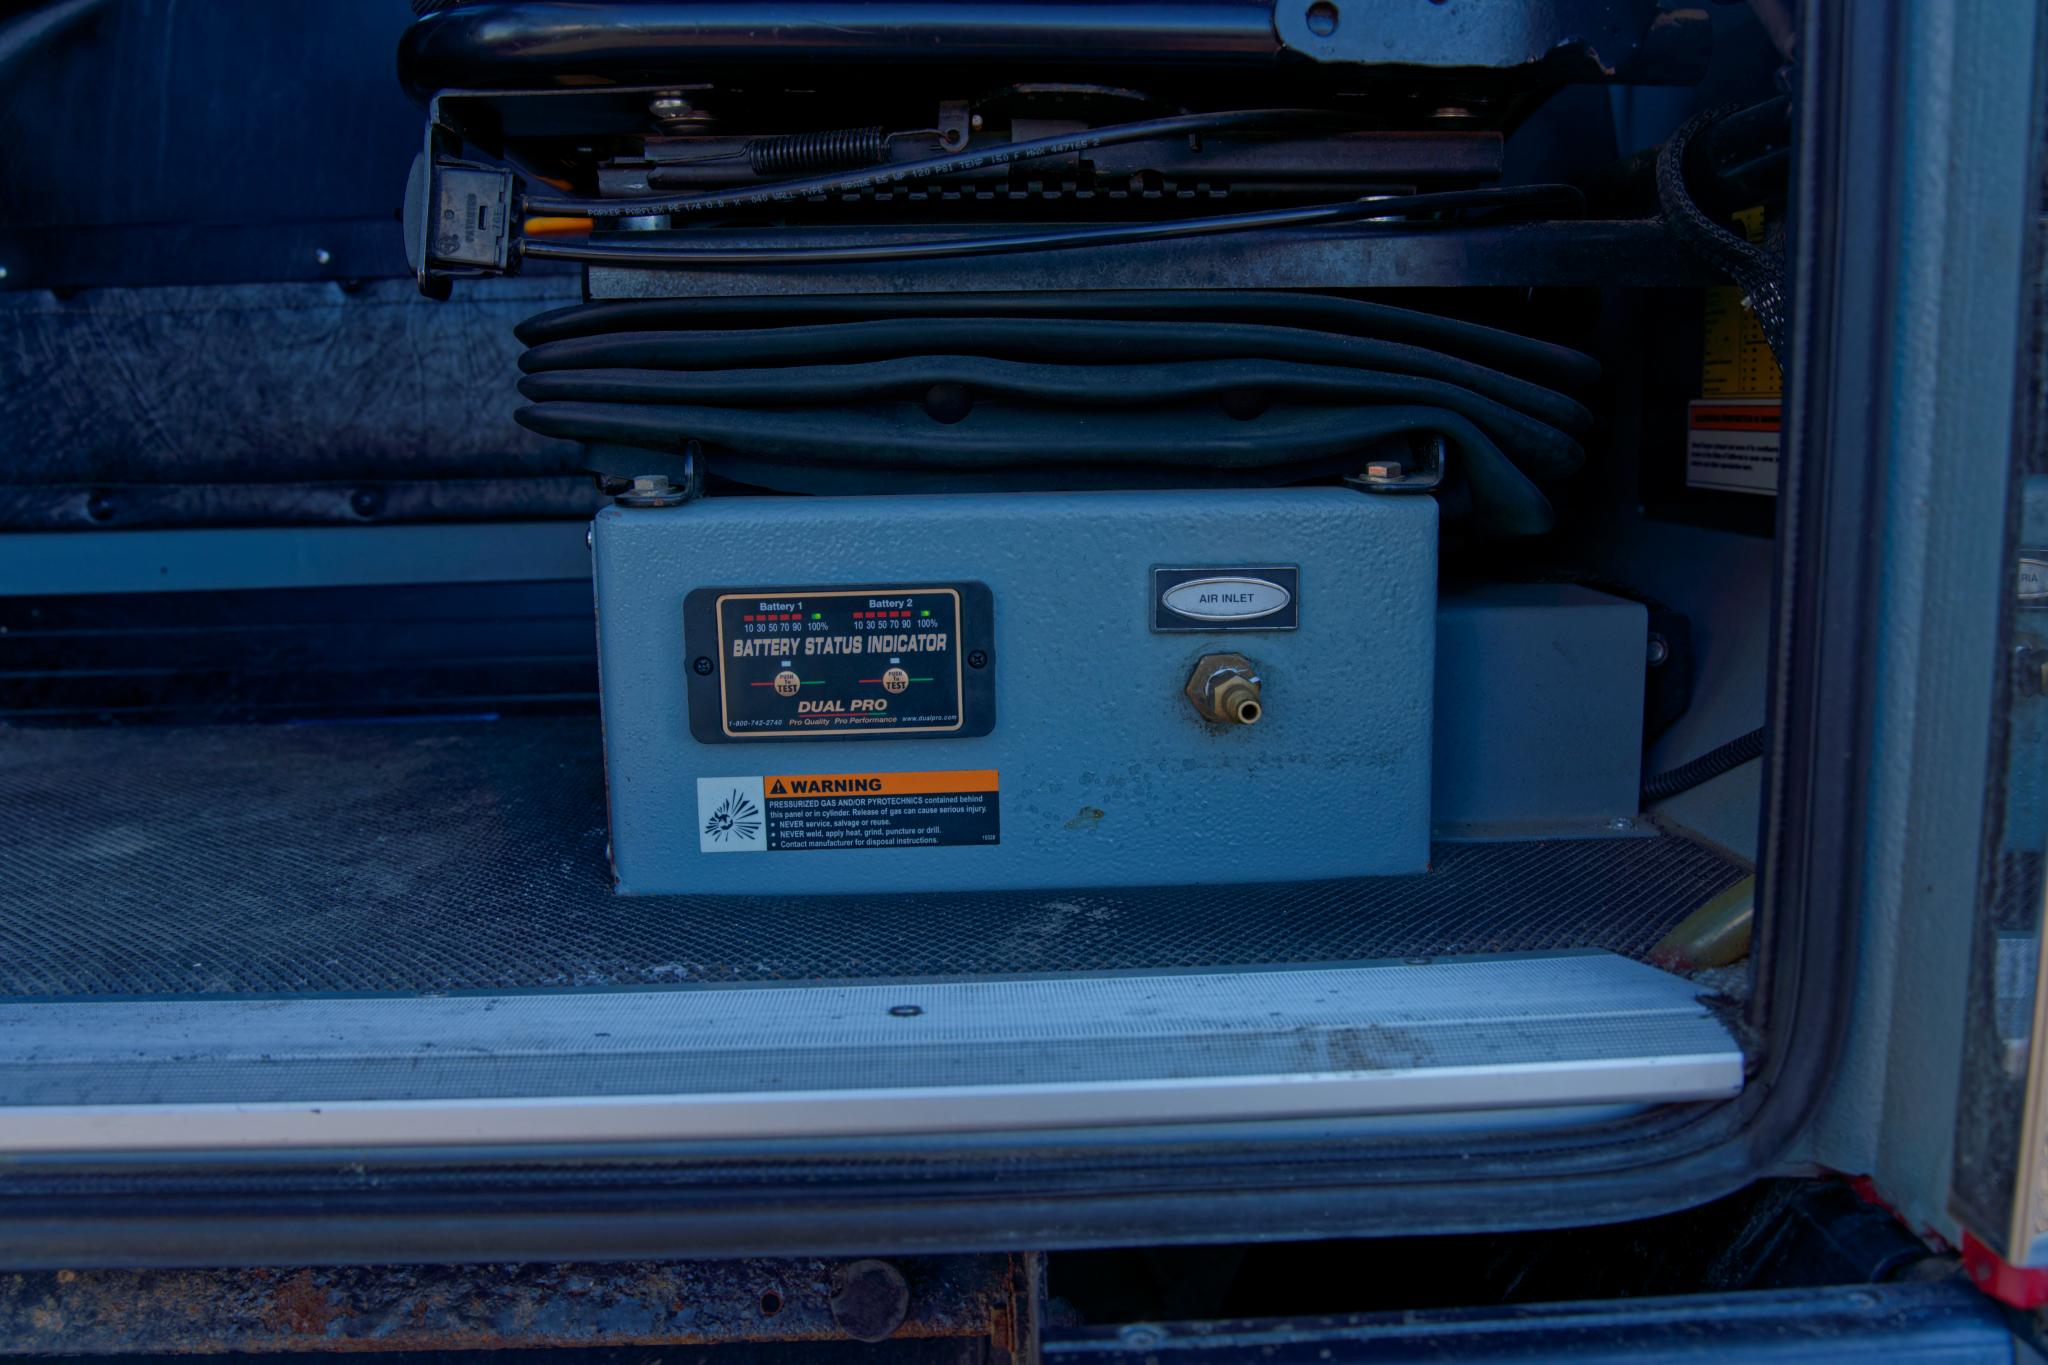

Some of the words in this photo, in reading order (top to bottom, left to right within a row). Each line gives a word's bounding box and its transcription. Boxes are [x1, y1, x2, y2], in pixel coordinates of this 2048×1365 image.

[800, 185, 825, 196] TYPE
[912, 168, 931, 178] 120
[935, 163, 953, 175] PSI
[959, 158, 984, 169] TEMP
[991, 153, 1009, 164] 150
[869, 599, 904, 609] Battery
[906, 598, 913, 607] 2
[1199, 594, 1218, 603] AIR
[1222, 593, 1255, 603] INLET
[760, 602, 795, 612] Battery
[797, 601, 803, 610] 1
[744, 623, 754, 633] 10
[756, 623, 766, 633] 30
[768, 623, 778, 632] 50
[780, 622, 790, 632] 70
[792, 622, 802, 631] 90
[807, 622, 829, 631] 100%
[854, 620, 863, 630] 10
[866, 620, 876, 629] 30
[878, 620, 887, 629] 50
[889, 619, 899, 629] 70
[901, 619, 911, 628] 90
[917, 618, 938, 628] 100%
[733, 637, 801, 657] BATTERY
[804, 635, 863, 655] STATUS
[867, 633, 947, 653] INDICATOR
[778, 684, 797, 693] TEST
[886, 682, 906, 690] TEST
[797, 699, 845, 713] DUAL
[850, 698, 888, 712] PRO
[804, 718, 830, 726] Quality
[834, 717, 848, 725] Pro
[849, 716, 897, 725] Performance
[902, 714, 957, 722] www.dualpro.com
[790, 778, 882, 793] WARNING
[769, 800, 819, 808] PRESSURIZED
[820, 799, 837, 807] GAS
[867, 796, 923, 806] PYROTECHNICS
[924, 795, 958, 804] contained
[959, 794, 983, 802] behind
[770, 810, 783, 818] this
[784, 810, 804, 819] panel
[822, 809, 851, 818] cylinder.
[852, 808, 879, 816] Release
[880, 807, 888, 815] of
[889, 808, 902, 816] gas
[780, 820, 804, 828] NEVER
[805, 820, 833, 828] service,
[833, 819, 860, 828] salvage
[780, 830, 805, 838] NEVER
[805, 830, 824, 838] weld,
[825, 830, 844, 839] apply
[845, 829, 863, 837] heat,
[864, 828, 884, 837] grind,
[885, 827, 916, 836] puncture
[926, 826, 942, 834] drill.
[780, 840, 808, 848] Contact
[808, 839, 853, 847] manufacturer
[855, 838, 865, 846] for
[866, 838, 895, 847] disposal
[896, 836, 938, 845] instructions.
